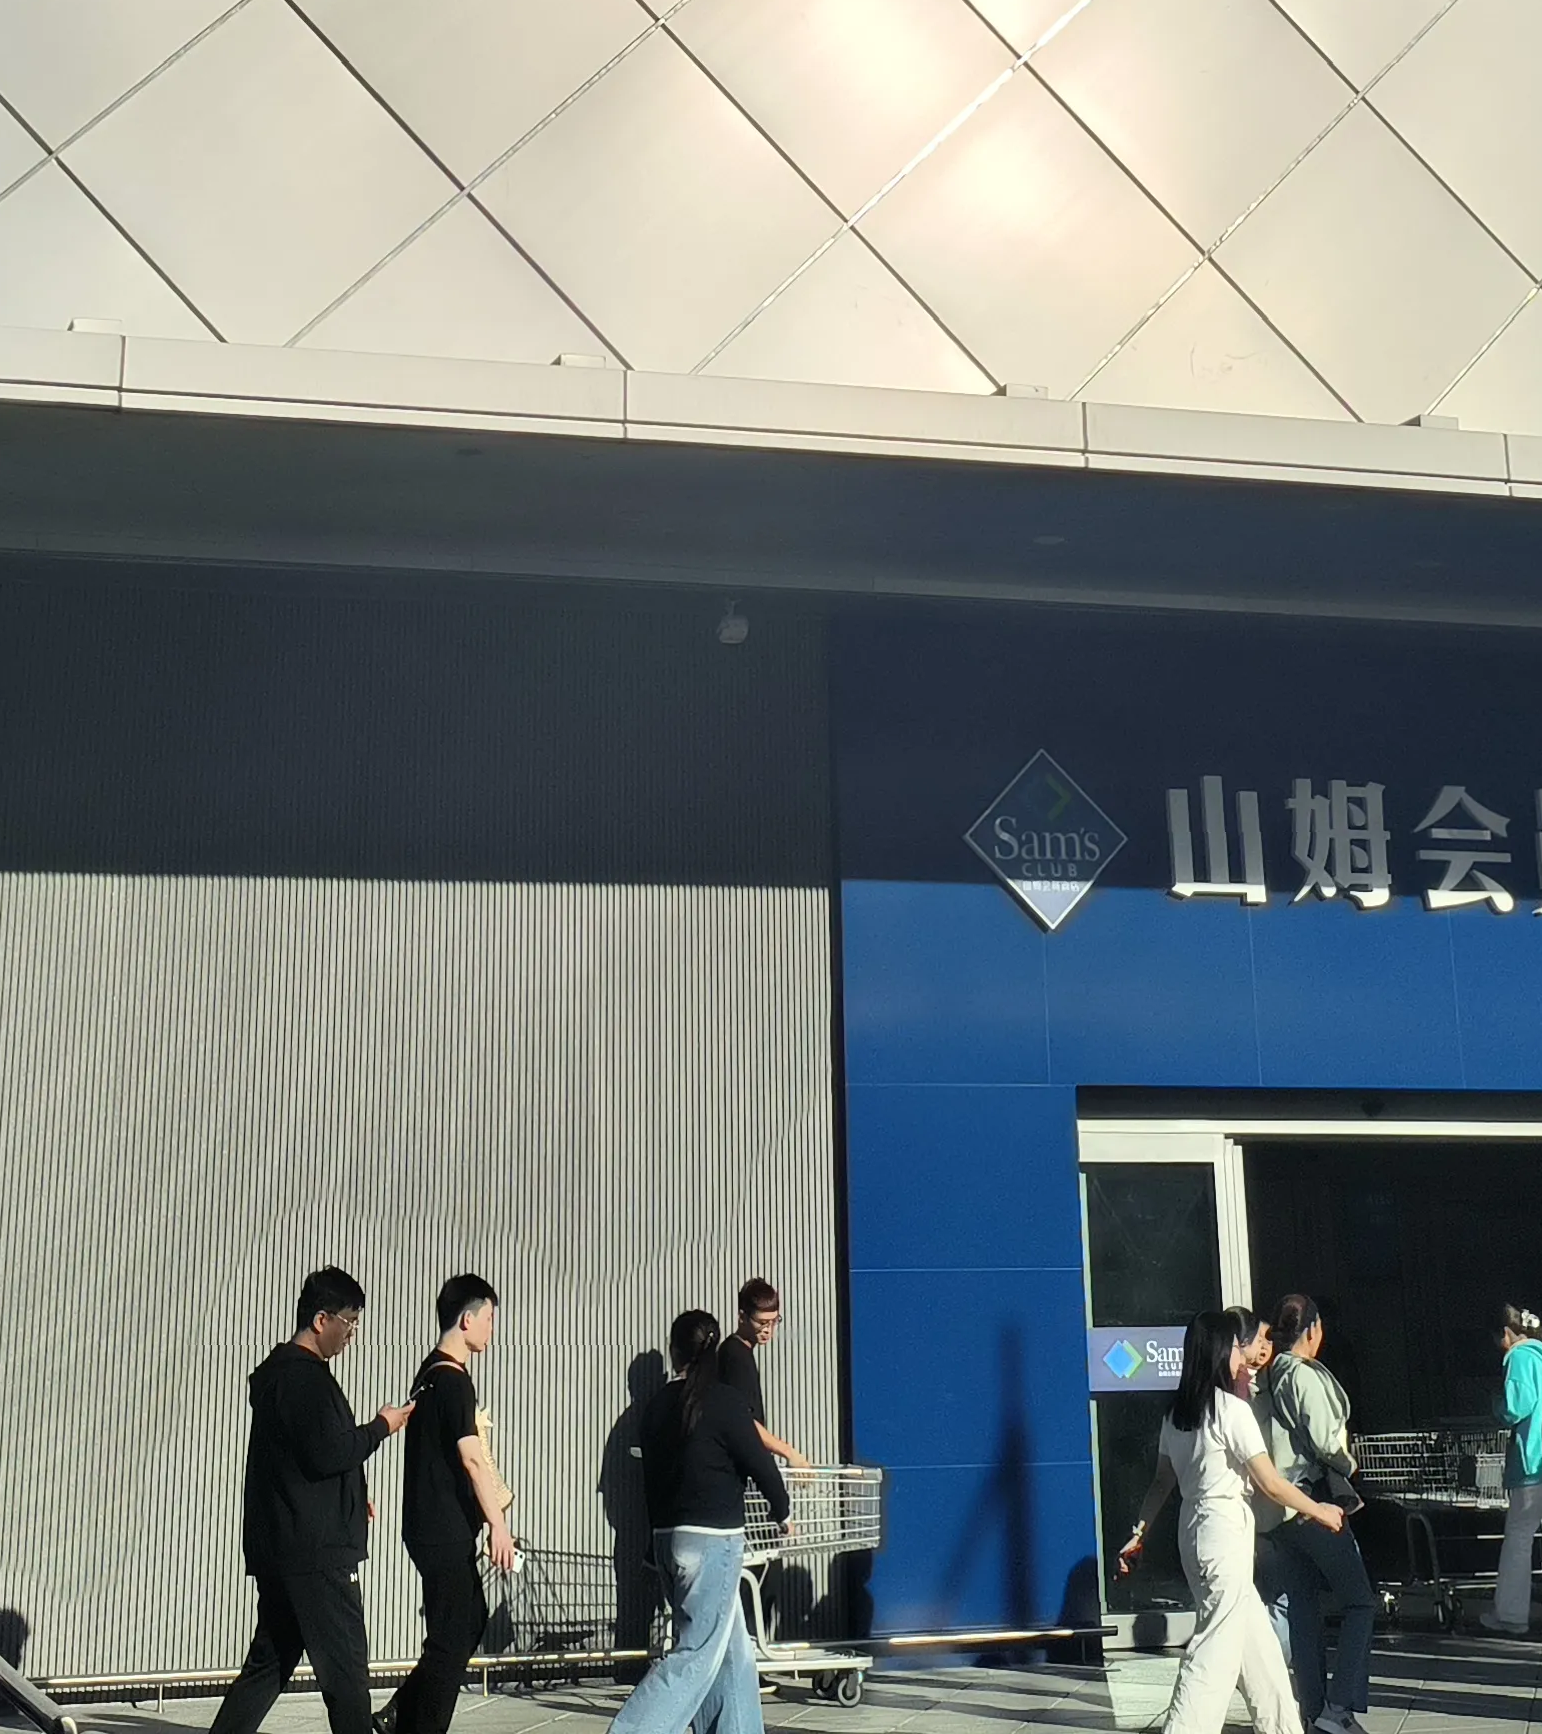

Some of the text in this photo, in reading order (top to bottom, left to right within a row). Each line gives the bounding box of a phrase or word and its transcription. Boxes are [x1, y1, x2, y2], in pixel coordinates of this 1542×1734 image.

[994, 816, 1100, 861] Sam's
[1022, 863, 1078, 876] CLUB
[1147, 1341, 1184, 1362] Sam
